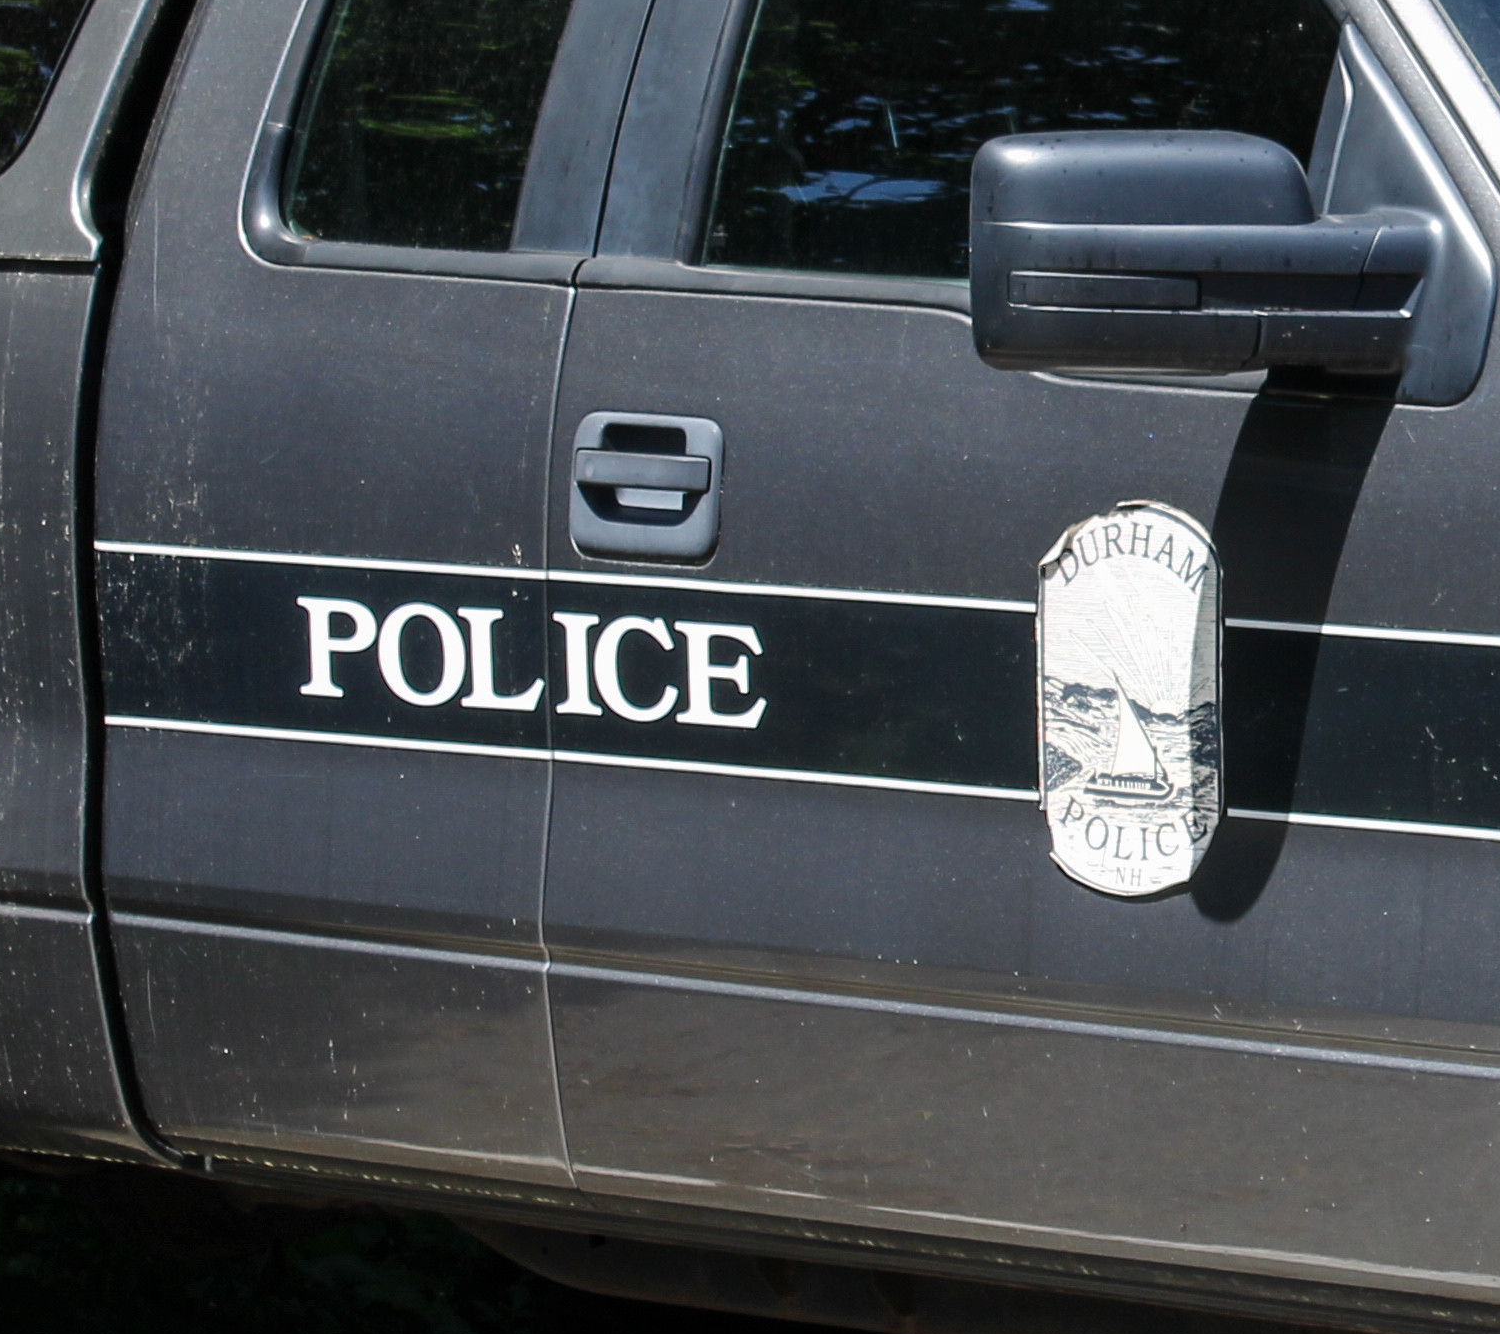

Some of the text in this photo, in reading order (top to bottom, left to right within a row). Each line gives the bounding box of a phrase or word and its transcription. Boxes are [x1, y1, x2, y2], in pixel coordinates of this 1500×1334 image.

[1057, 520, 1210, 596] DURHAM
[296, 595, 768, 730] POLICE
[1058, 796, 1210, 862] POLICE
[1114, 866, 1143, 888] NH
